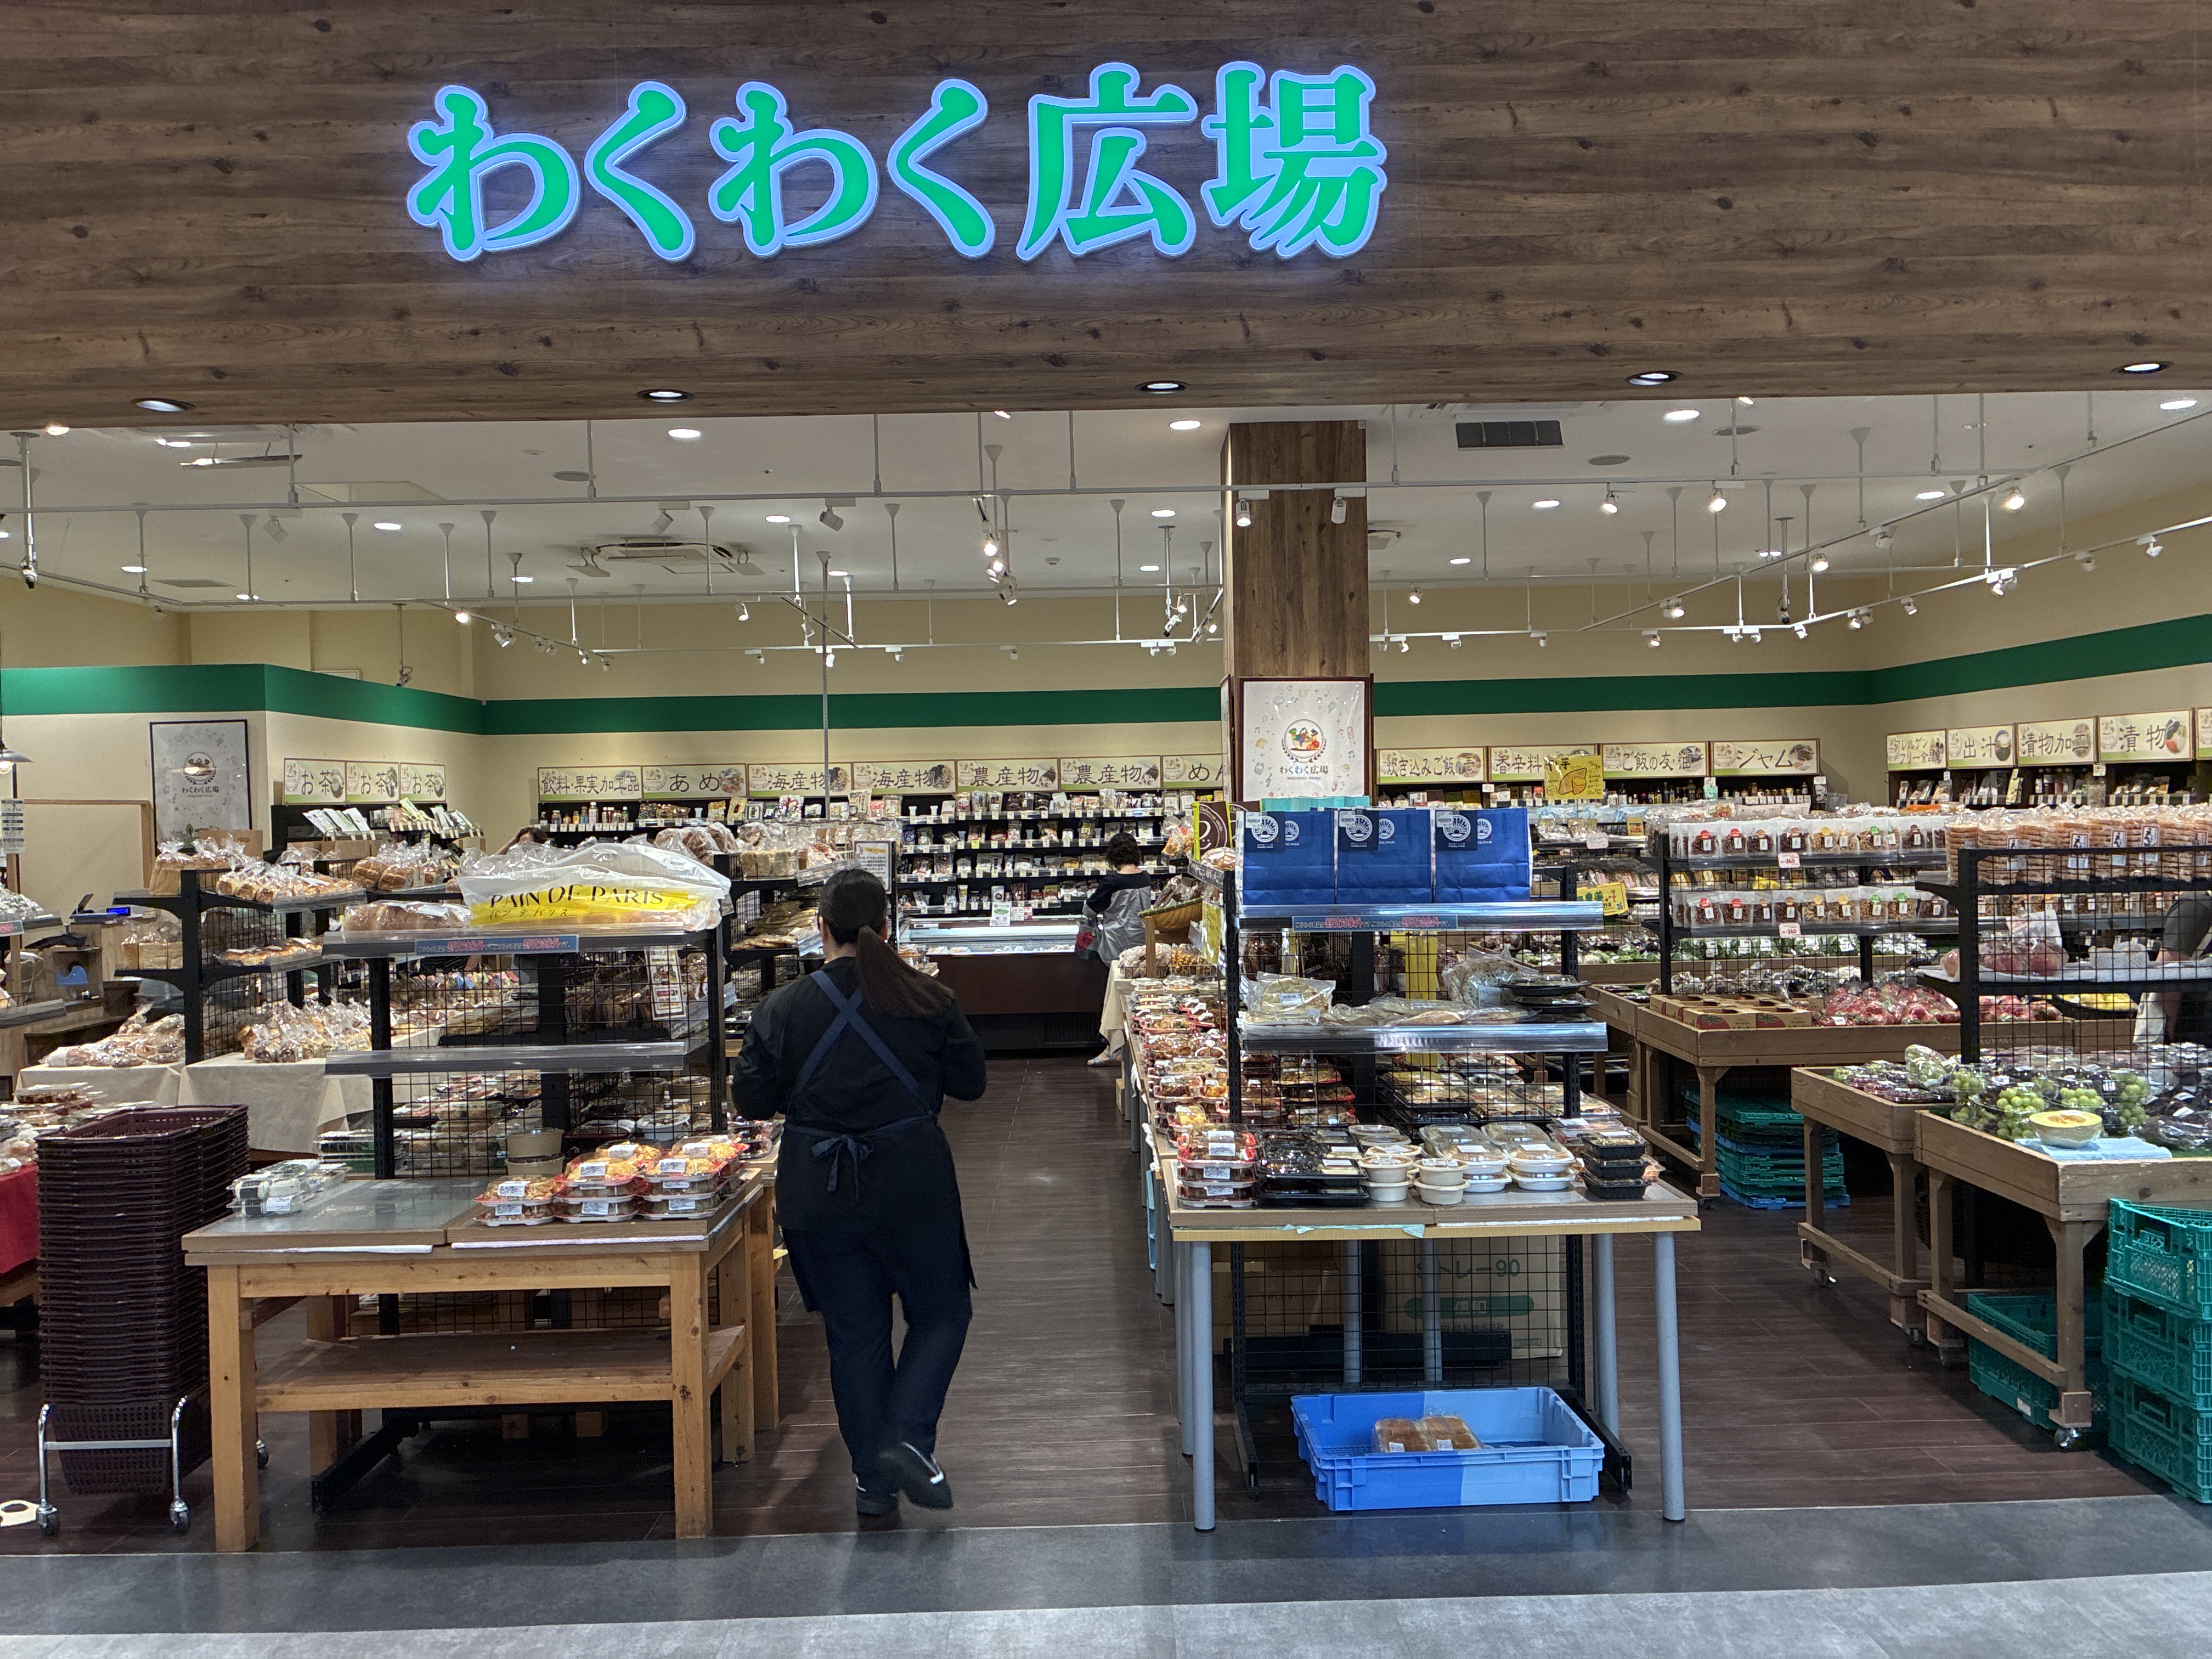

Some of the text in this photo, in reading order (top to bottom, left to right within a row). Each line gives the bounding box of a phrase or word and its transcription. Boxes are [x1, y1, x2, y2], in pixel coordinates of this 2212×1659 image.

[407, 61, 1387, 262] わくわく広場
[1963, 736, 1996, 758] 出汁
[2020, 732, 2090, 757] 漬物加工
[2119, 724, 2166, 752] 漬物
[1279, 765, 1329, 774] わくわく広場
[1496, 754, 1562, 775] 香辛料
[1736, 748, 1793, 769] ジャム
[301, 770, 333, 795] お茶
[360, 771, 388, 795] お茶
[412, 772, 436, 795] お茶
[670, 772, 720, 792] あめ
[873, 768, 935, 789] 海産物
[970, 766, 1039, 788] 農産物
[1074, 764, 1142, 785] 農産物
[490, 884, 663, 908] PAIN DE PARIS
